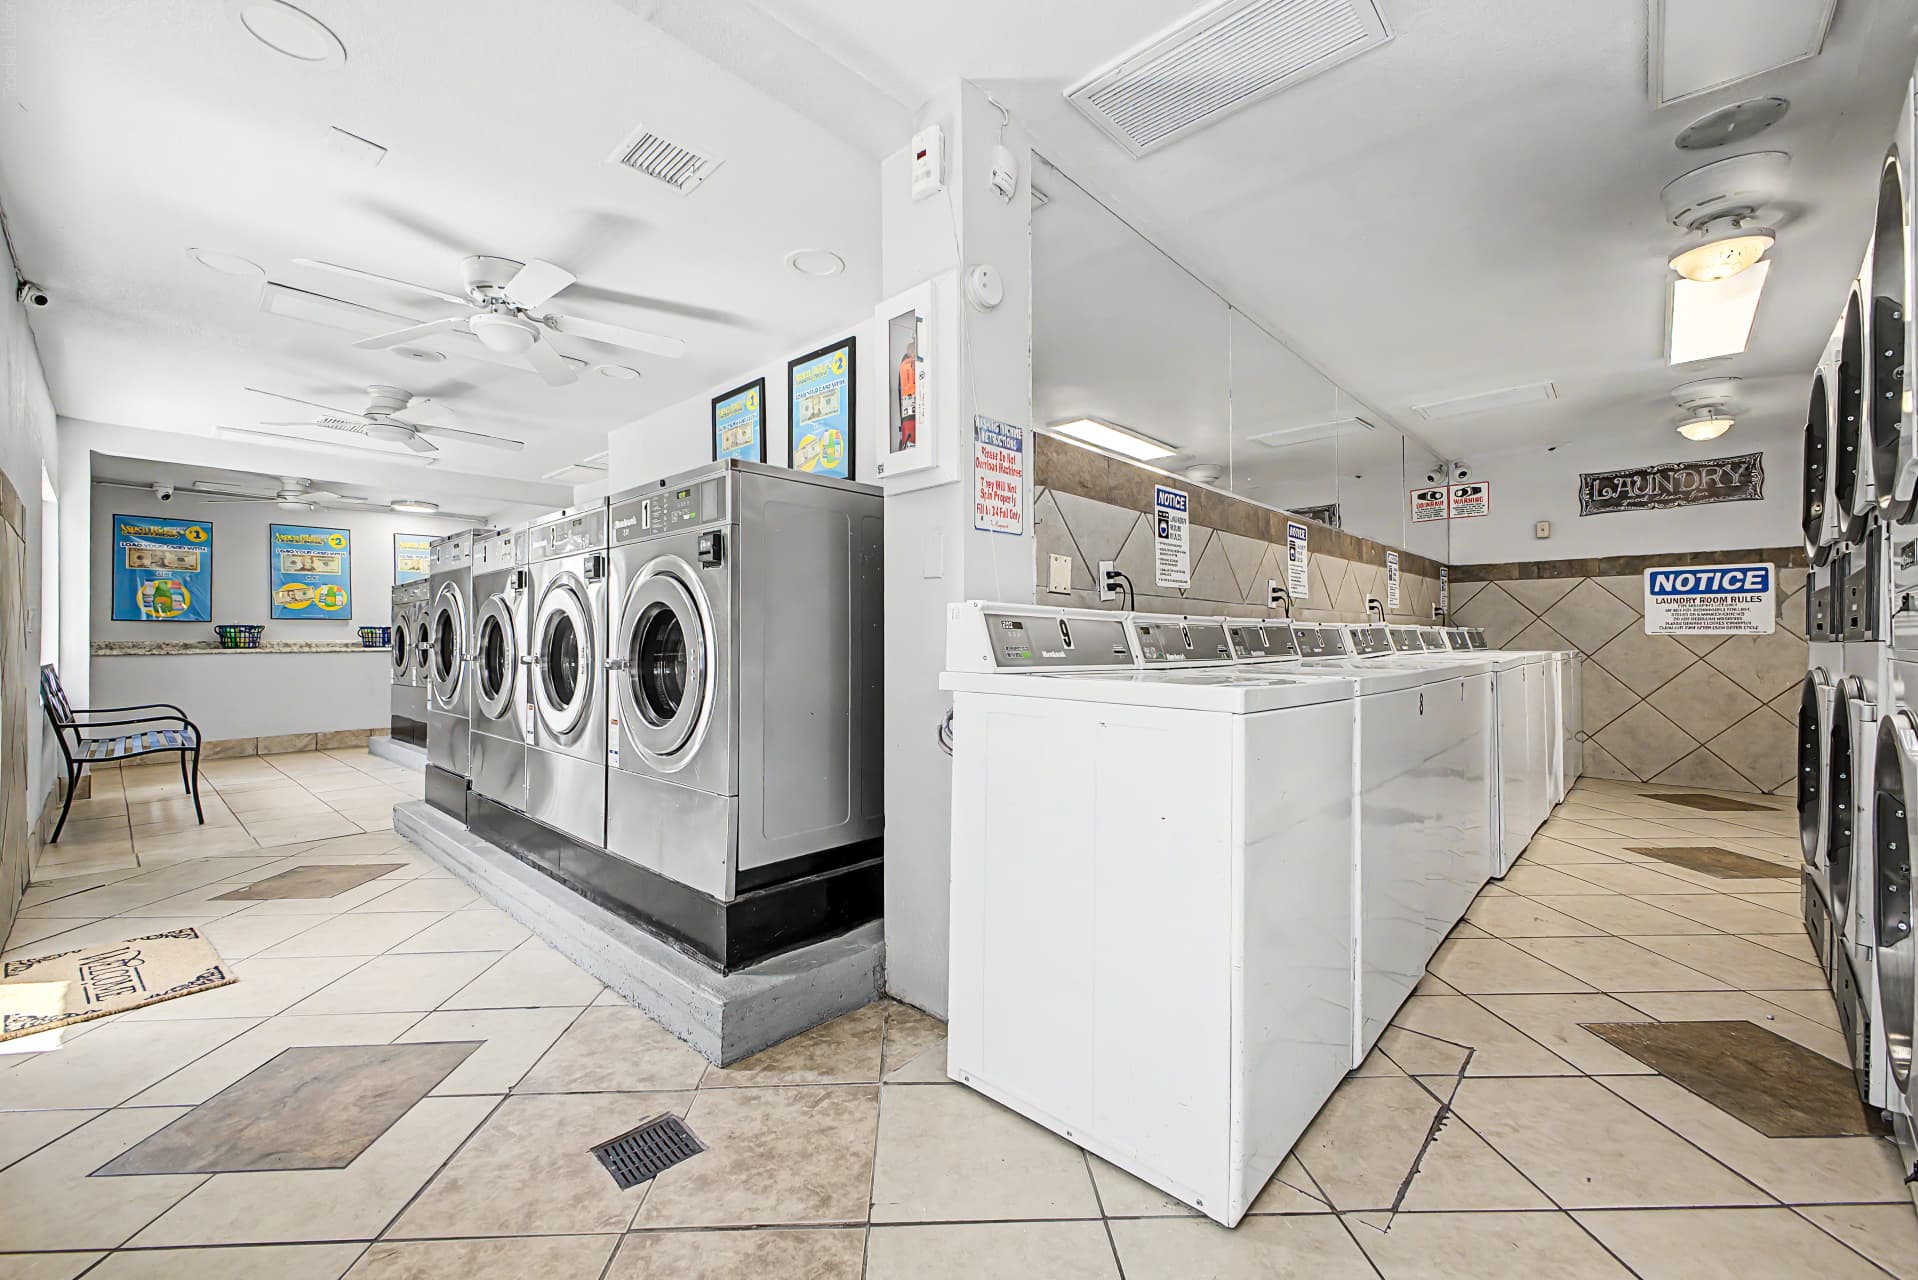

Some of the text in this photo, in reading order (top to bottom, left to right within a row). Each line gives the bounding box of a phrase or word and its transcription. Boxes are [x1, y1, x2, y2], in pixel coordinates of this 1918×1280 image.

[981, 446, 999, 461] Please
[1007, 452, 1016, 465] Not
[975, 457, 1022, 478] Overload Machines
[980, 476, 995, 492] They
[995, 480, 1006, 492] Will
[1593, 463, 1748, 501] LAUNDRY
[980, 488, 1016, 508] Spin Properly
[1158, 490, 1185, 511] NOTICE
[1453, 496, 1484, 506] WARNING
[1621, 495, 1649, 506] good
[976, 503, 984, 515] Fill
[999, 506, 1009, 518] Full
[1009, 508, 1021, 523] Only
[1653, 570, 1766, 592] NOTICE
[1655, 595, 1762, 605] LAUNDRY ROOM RULES
[1058, 618, 1072, 648] 9
[1182, 625, 1192, 648] 8
[1419, 692, 1424, 716] 8
[78, 946, 145, 1003] WELCOME
